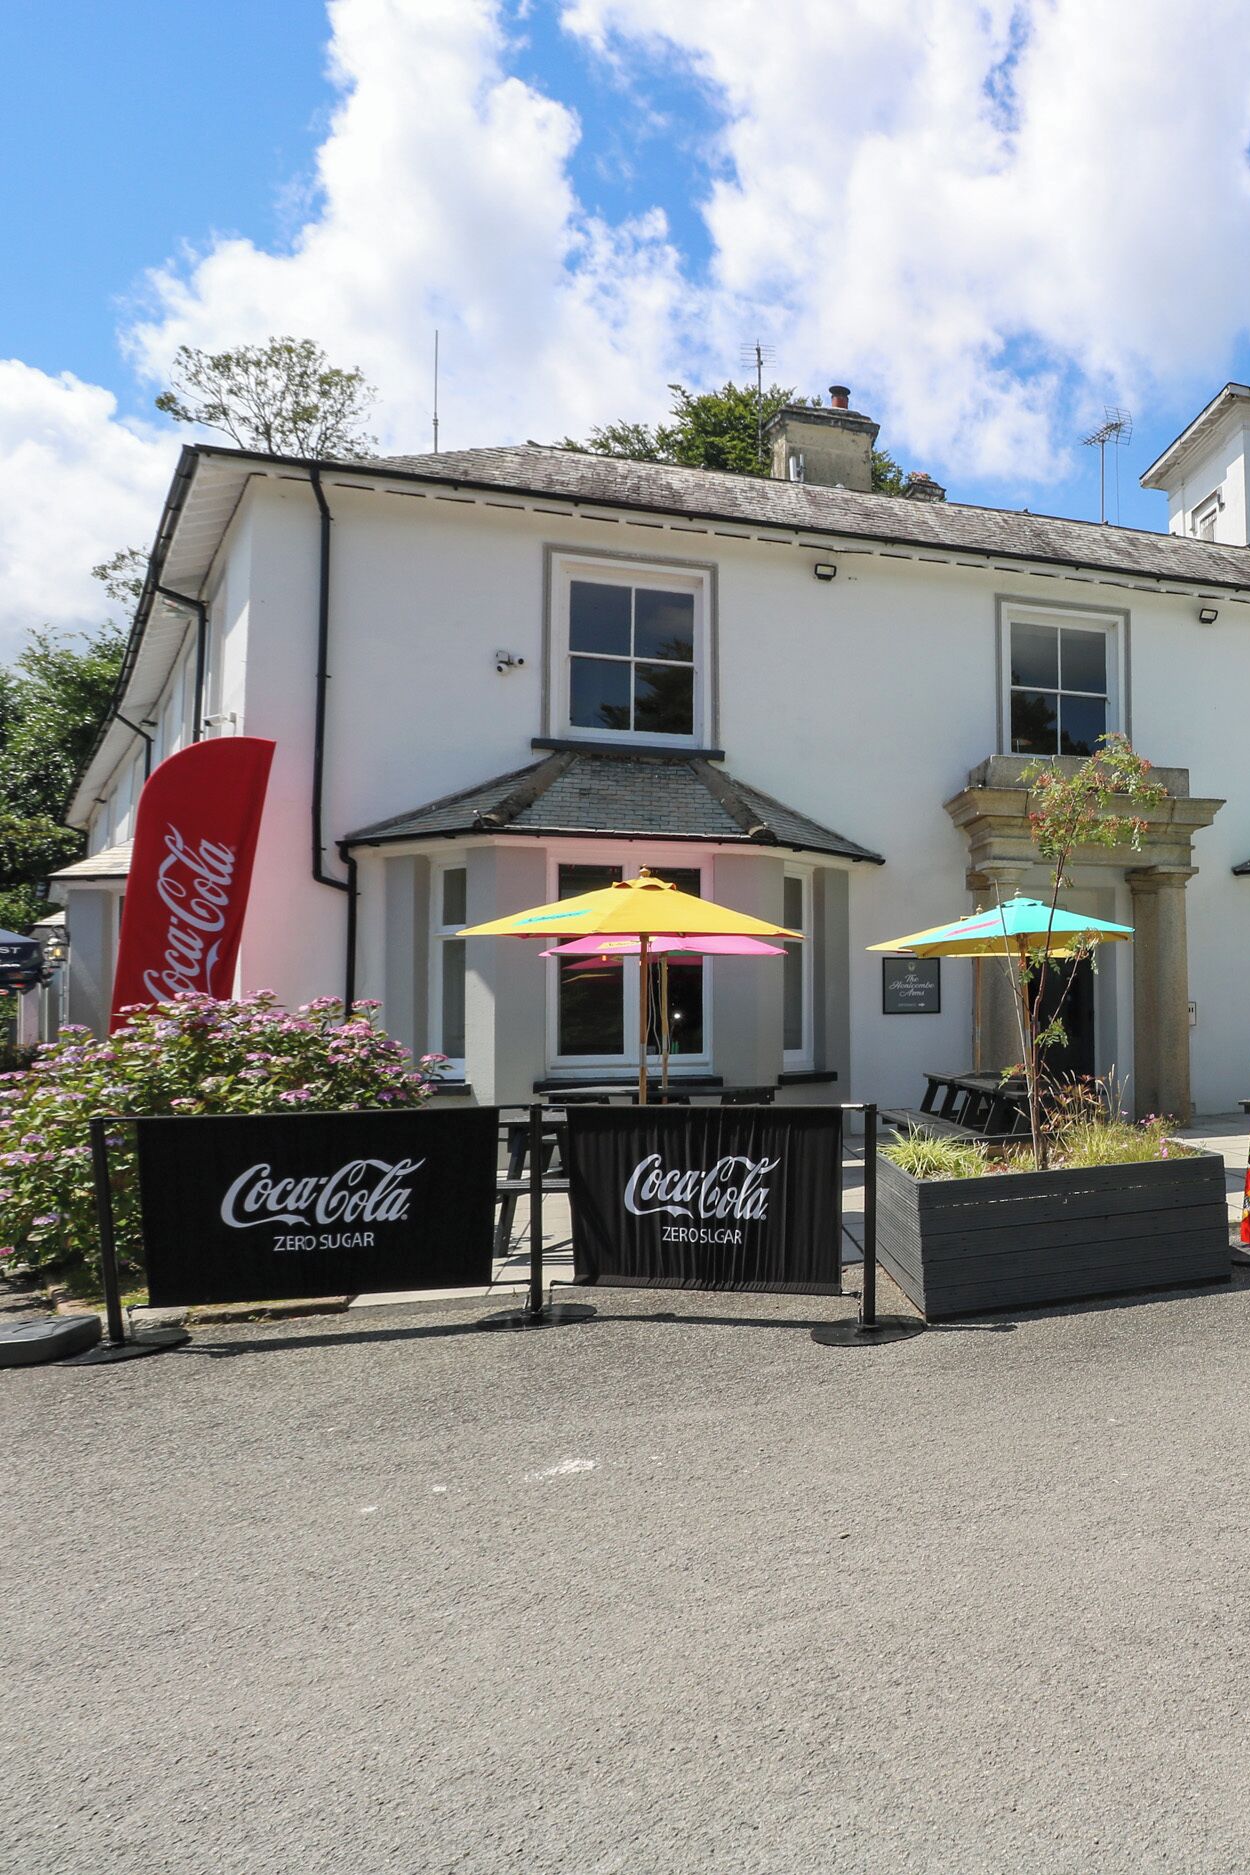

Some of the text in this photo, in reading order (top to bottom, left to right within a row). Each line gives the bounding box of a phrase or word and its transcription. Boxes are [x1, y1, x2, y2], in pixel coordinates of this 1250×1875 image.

[905, 974, 919, 983] The
[221, 1158, 425, 1228] Coca-Cola
[624, 1153, 781, 1220] Coca-Cola
[273, 1231, 375, 1252] ZERO SUGAR
[662, 1226, 699, 1244] ZERO
